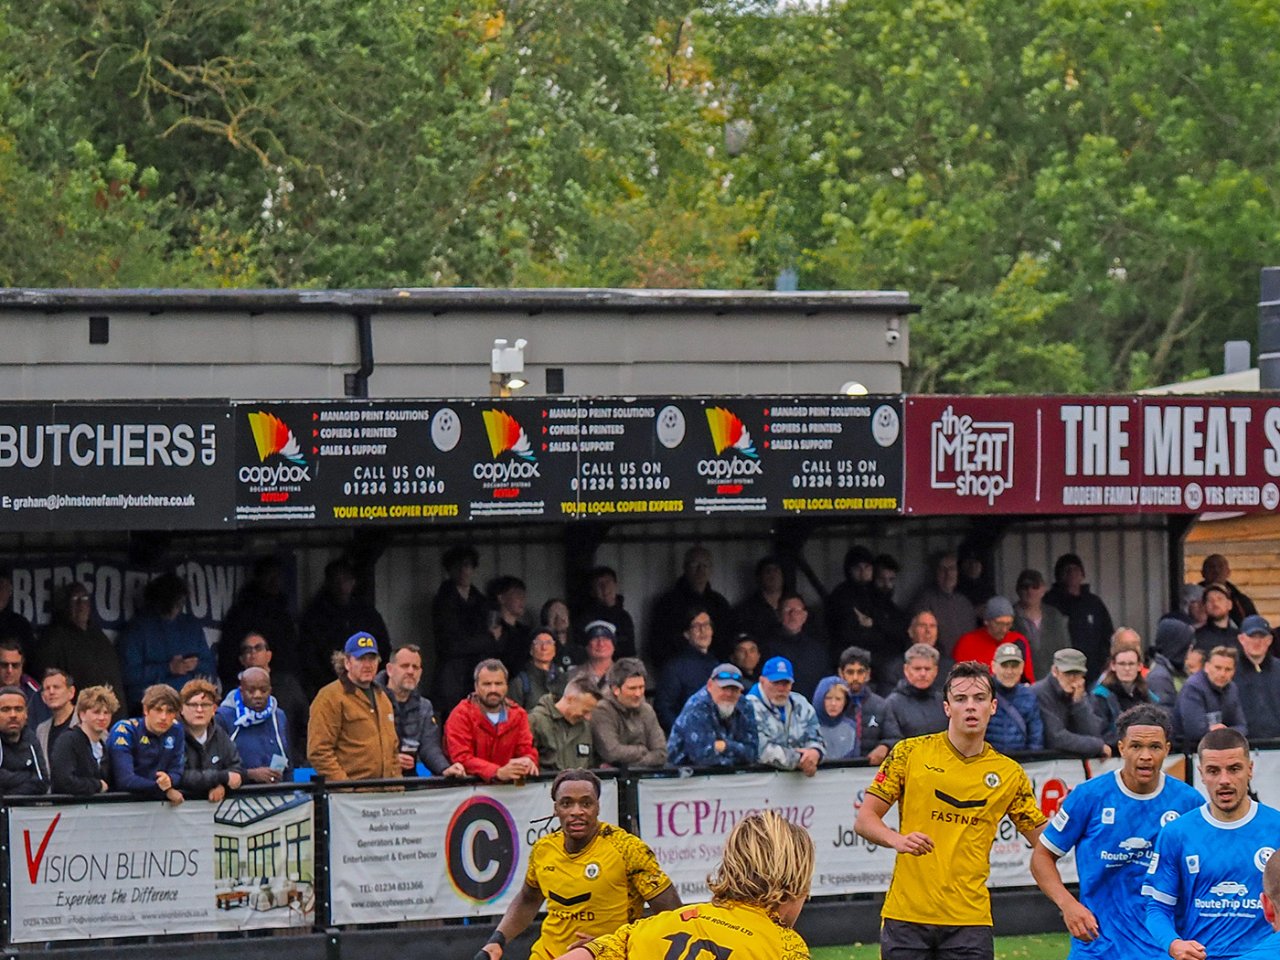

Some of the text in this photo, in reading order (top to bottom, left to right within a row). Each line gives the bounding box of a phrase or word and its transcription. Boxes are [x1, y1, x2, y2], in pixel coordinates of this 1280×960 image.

[320, 409, 430, 421] MANAGED PRINT SOLUTIONS
[549, 407, 656, 418] MANAGED PRINT SOLUTIONS
[808, 407, 830, 417] PRINT
[830, 406, 871, 417] SOLUTIONS
[940, 405, 973, 435] the
[320, 428, 351, 439] COPIERS
[361, 427, 398, 438] PRINTERS
[549, 425, 580, 436] COPIERS
[588, 424, 625, 435] PRINTERS
[771, 423, 842, 433] COPIERS PRINTERS
[0, 423, 216, 468] BUTCHERS LTD
[549, 442, 572, 453] SALES
[579, 441, 615, 452] SUPPORT
[771, 440, 833, 450] SALES SUPPORT
[1060, 405, 1130, 476] THE
[1144, 405, 1252, 476] MEAT
[320, 445, 344, 456] SALES
[351, 444, 387, 455] SUPPORT
[937, 430, 1008, 472] MEAT
[238, 461, 312, 486] copybox
[354, 465, 436, 480] CALL US ON
[473, 459, 541, 482] copybox
[582, 462, 662, 476] CALL US ON
[697, 456, 763, 478] copybox
[802, 460, 877, 473] CALL US ON
[343, 480, 445, 495] 01234 331360
[571, 476, 670, 490] 01234 331360
[792, 474, 885, 488] 01234 331360
[956, 469, 1005, 506] shop
[2, 494, 12, 509] E:
[1103, 486, 1139, 505] FAMILY
[333, 505, 359, 518] YOUR
[359, 505, 388, 518] LOCAL
[389, 505, 421, 517] COPIER
[422, 504, 459, 517] EXPERTS
[561, 502, 587, 514] YOUR
[587, 501, 615, 514] LOCAL
[616, 501, 648, 513] COPIER
[649, 500, 684, 512] EXPERTS
[783, 498, 897, 510] YOUR LOCAL COPIER EXPERTS
[357, 636, 374, 648] CA
[361, 806, 417, 819] Stage Structures
[368, 821, 410, 833] Audio Visual
[23, 811, 199, 885] VISION BLINDS
[356, 838, 394, 849] Generators
[401, 836, 422, 846] Power
[342, 853, 391, 864] Entertainment
[397, 852, 417, 861] Event
[417, 850, 438, 860] Decor
[374, 882, 397, 893] 01234
[55, 884, 180, 911] Experience the Difference
[1194, 898, 1264, 911] RouteTrip USA
[741, 927, 754, 937] LTD
